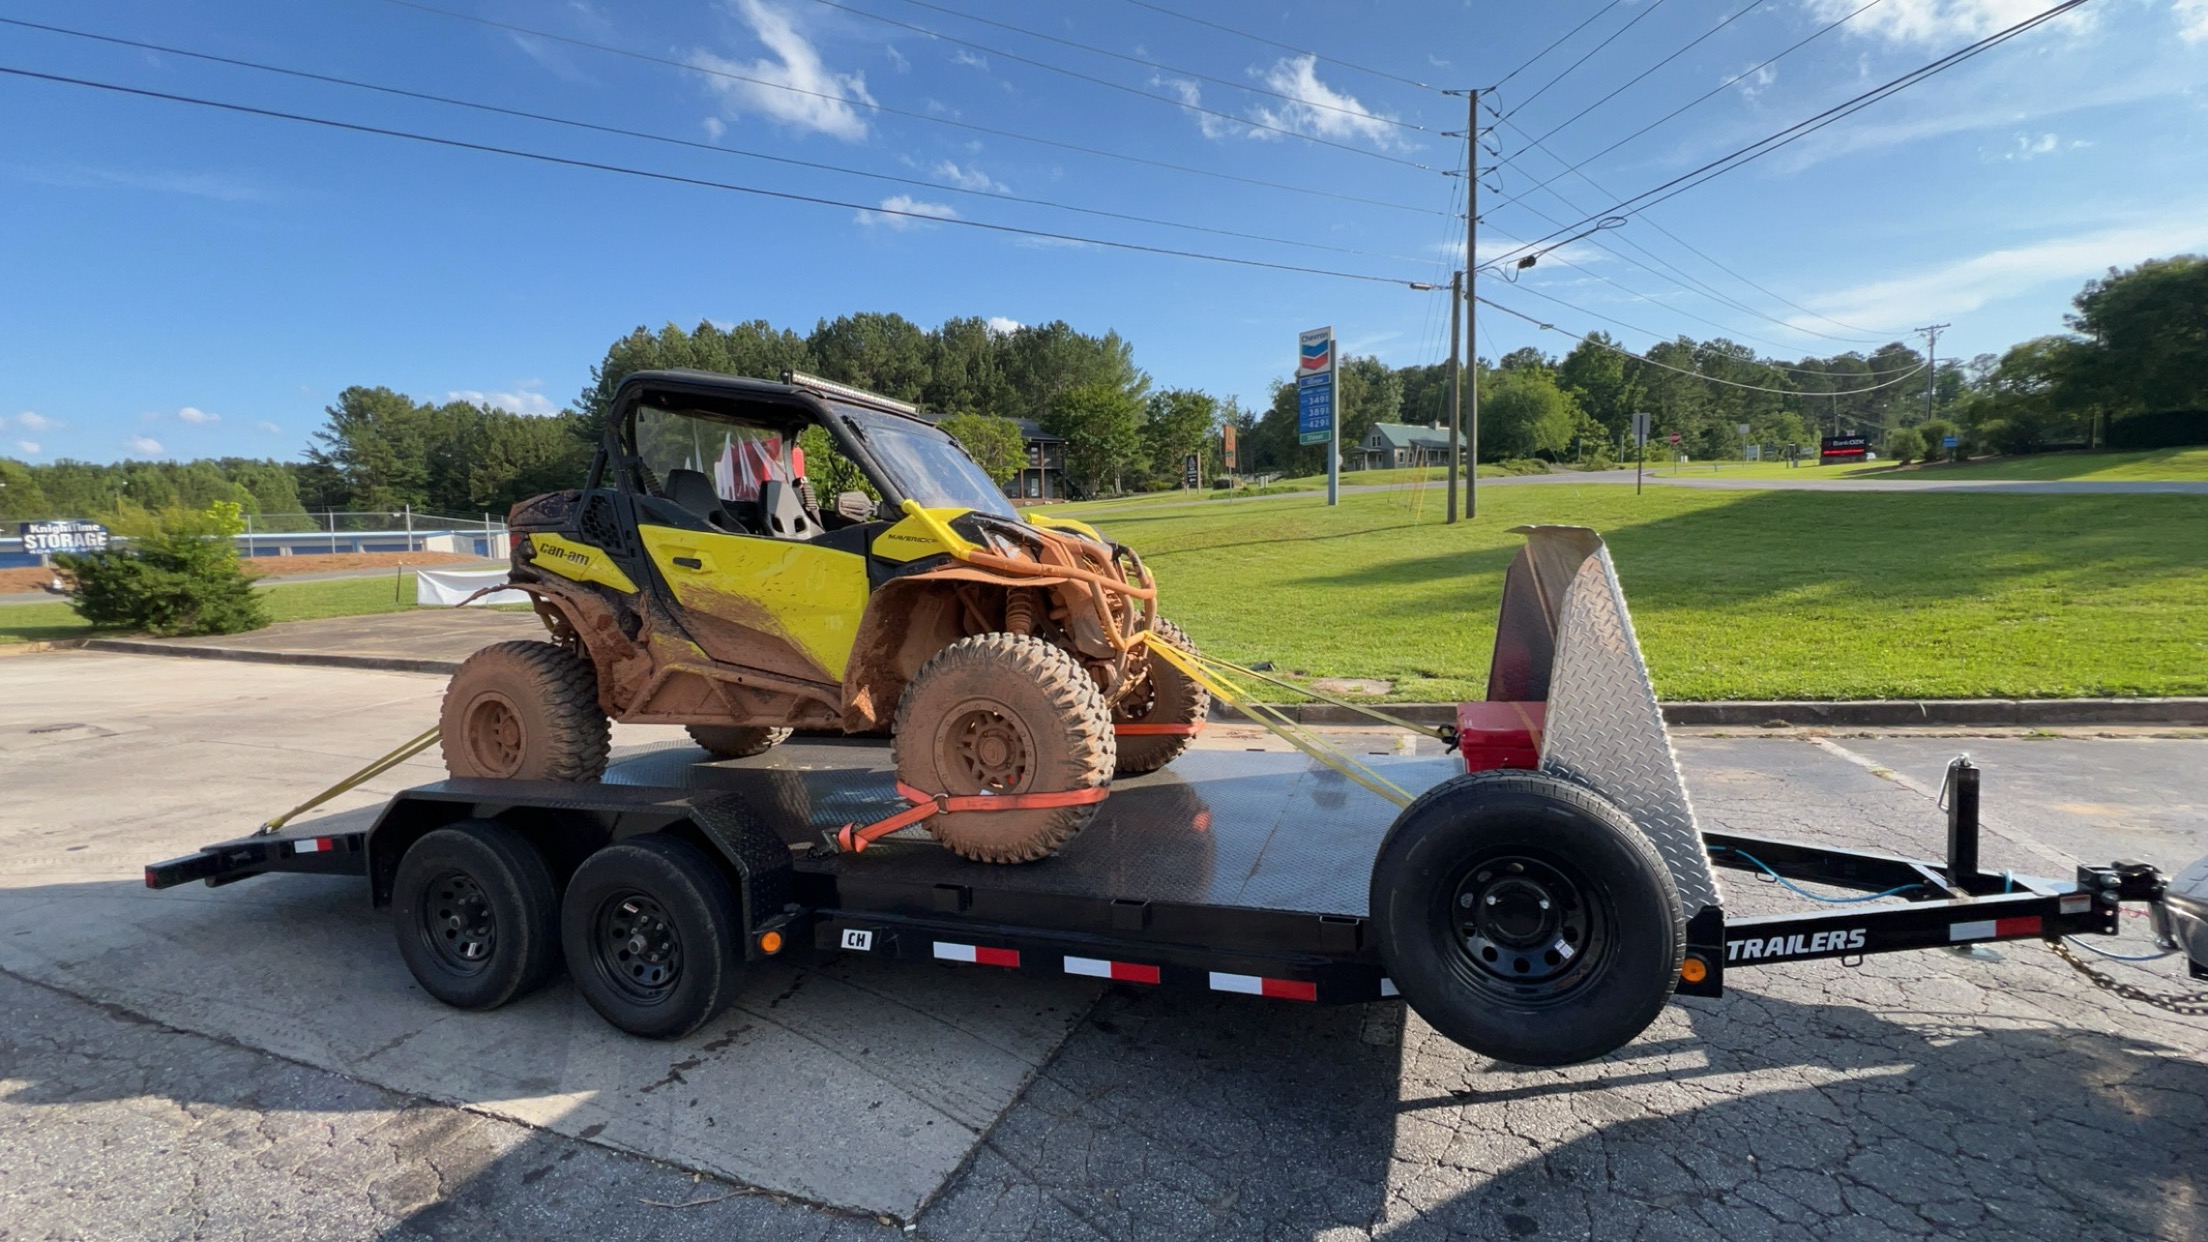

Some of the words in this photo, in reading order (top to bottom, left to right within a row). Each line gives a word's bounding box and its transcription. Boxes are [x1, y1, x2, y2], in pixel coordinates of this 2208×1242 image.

[1301, 331, 1328, 343] Chevron
[24, 532, 107, 549] STORAGE
[540, 543, 590, 566] can-am
[847, 932, 866, 947] CH
[1726, 928, 1867, 961] TRAILERS
